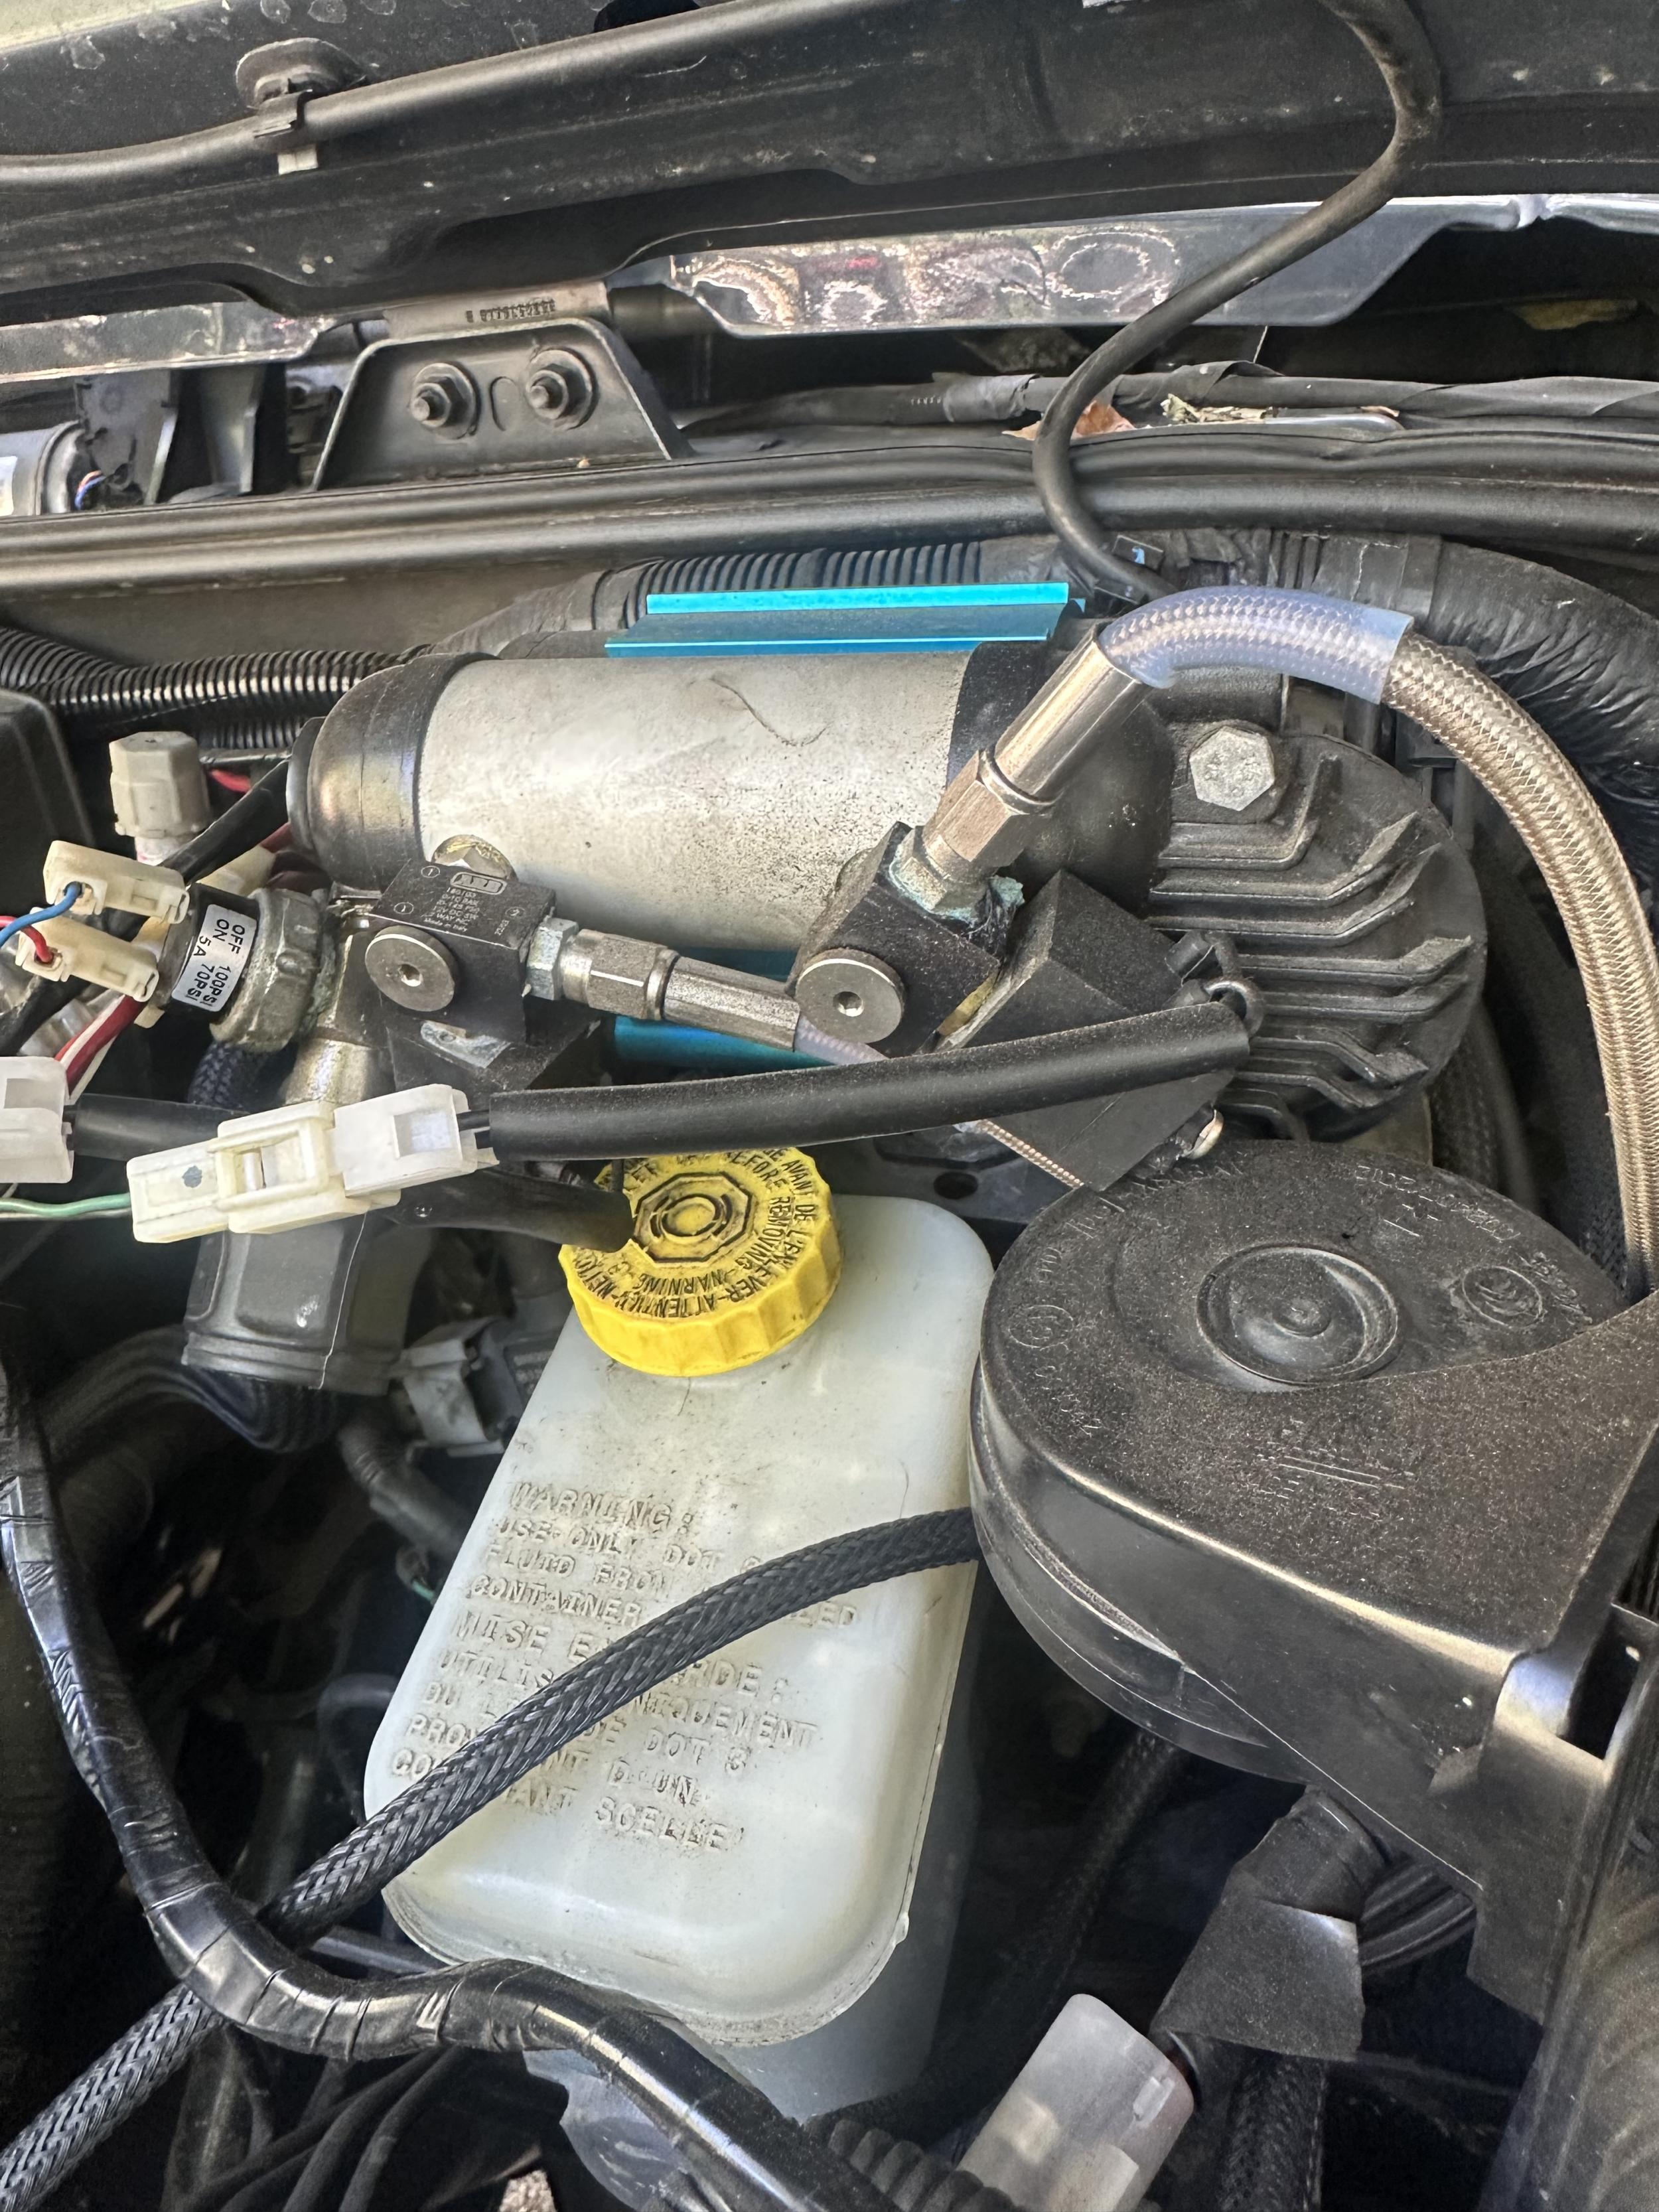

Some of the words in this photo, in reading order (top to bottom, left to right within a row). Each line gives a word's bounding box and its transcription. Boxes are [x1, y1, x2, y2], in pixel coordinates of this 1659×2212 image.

[212, 918, 230, 942] ON
[228, 924, 246, 954] OFF
[185, 963, 216, 1001] 70PSI
[200, 965, 232, 1007] 100PSI
[664, 1544, 725, 1572] DOT
